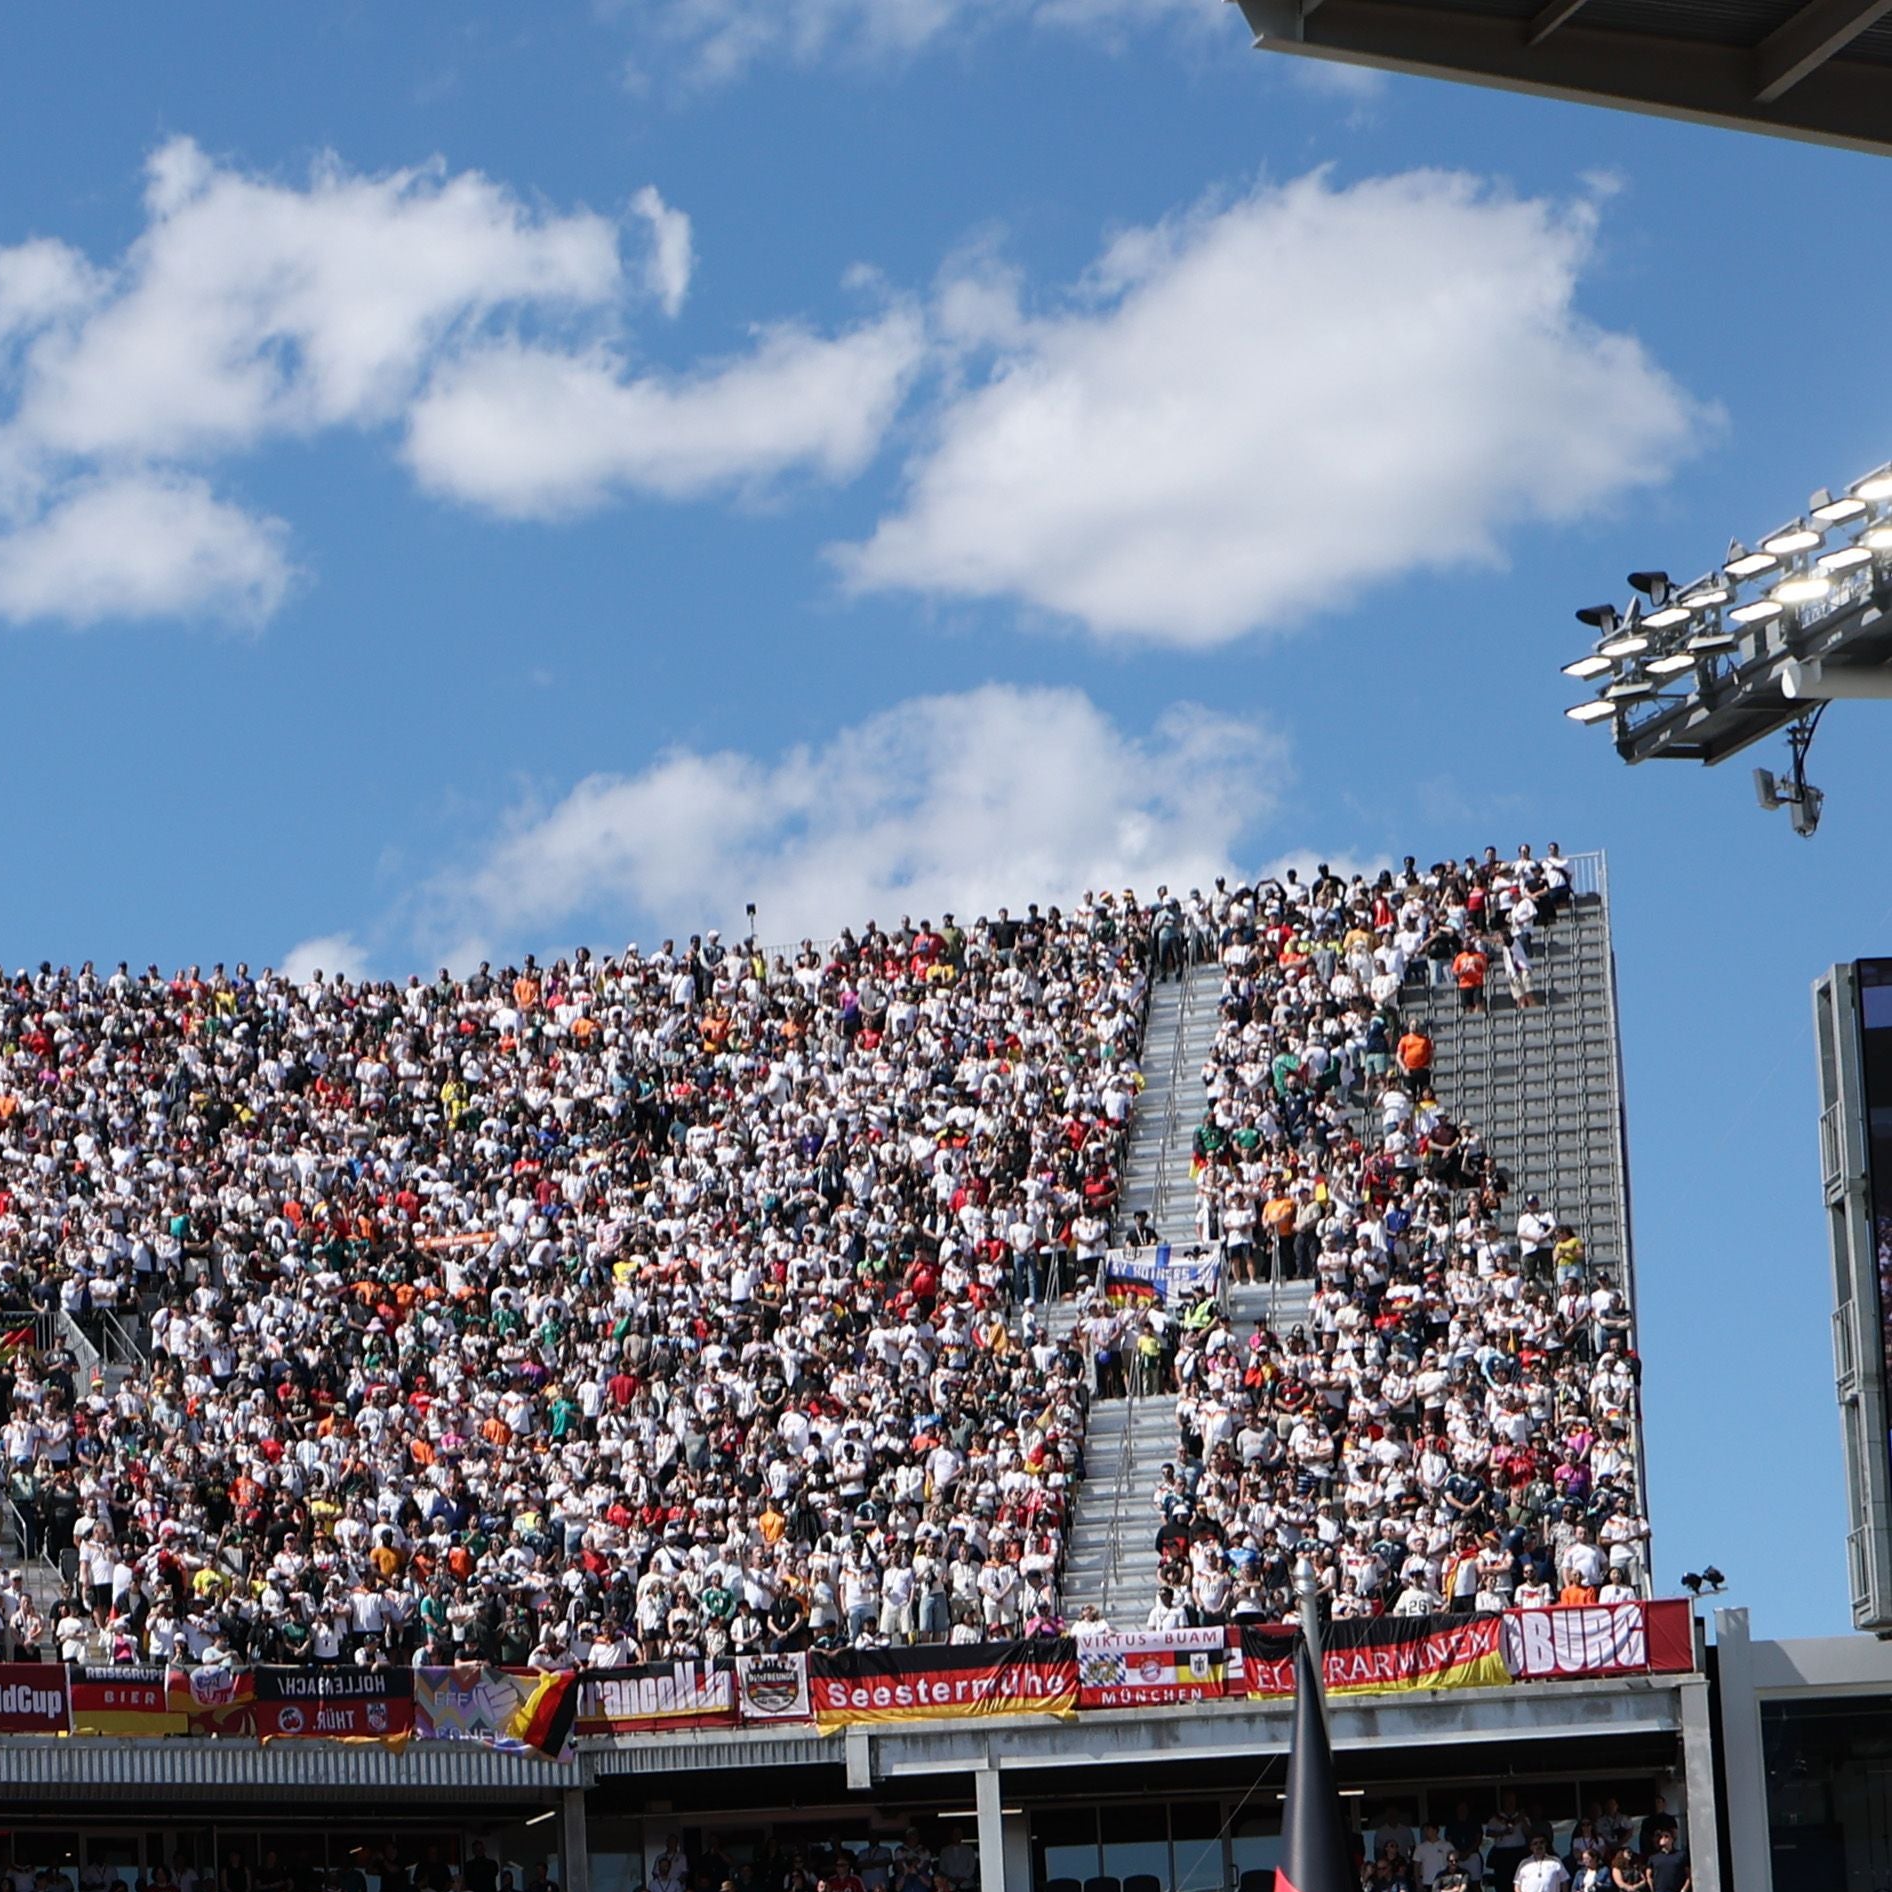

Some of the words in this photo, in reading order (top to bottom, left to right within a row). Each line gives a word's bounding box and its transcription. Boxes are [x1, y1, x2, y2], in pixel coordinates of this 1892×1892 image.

[1408, 1600, 1429, 1614] 26
[1083, 1633, 1147, 1649] VIKTUS
[1165, 1630, 1218, 1645] BUAM
[1101, 1685, 1204, 1706] MÜNCHEN
